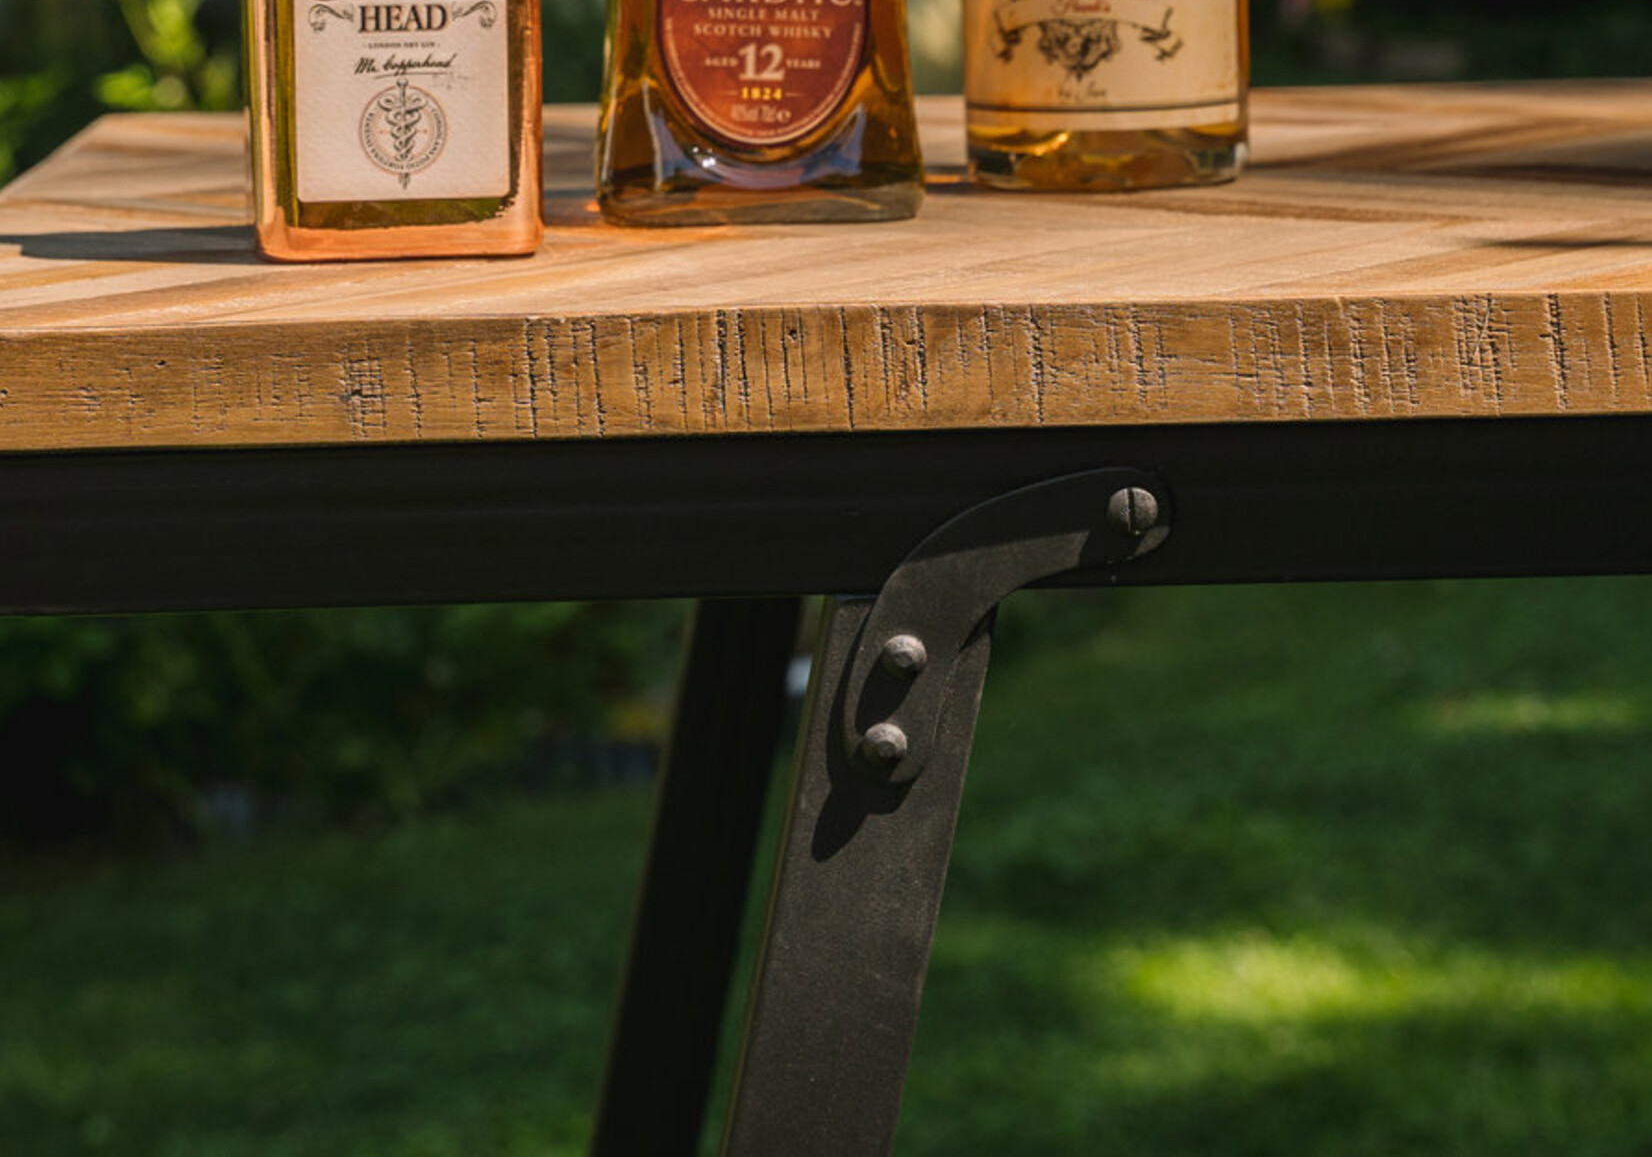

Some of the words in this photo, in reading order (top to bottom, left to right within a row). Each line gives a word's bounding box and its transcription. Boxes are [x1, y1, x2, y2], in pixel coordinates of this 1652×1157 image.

[358, 3, 448, 34] HEAD
[708, 6, 767, 21] SINGLE
[774, 7, 821, 22] MALT
[693, 23, 762, 38] SCOTCH
[769, 24, 833, 40] WHISKY
[738, 42, 786, 82] 12
[786, 58, 822, 70] YEARS
